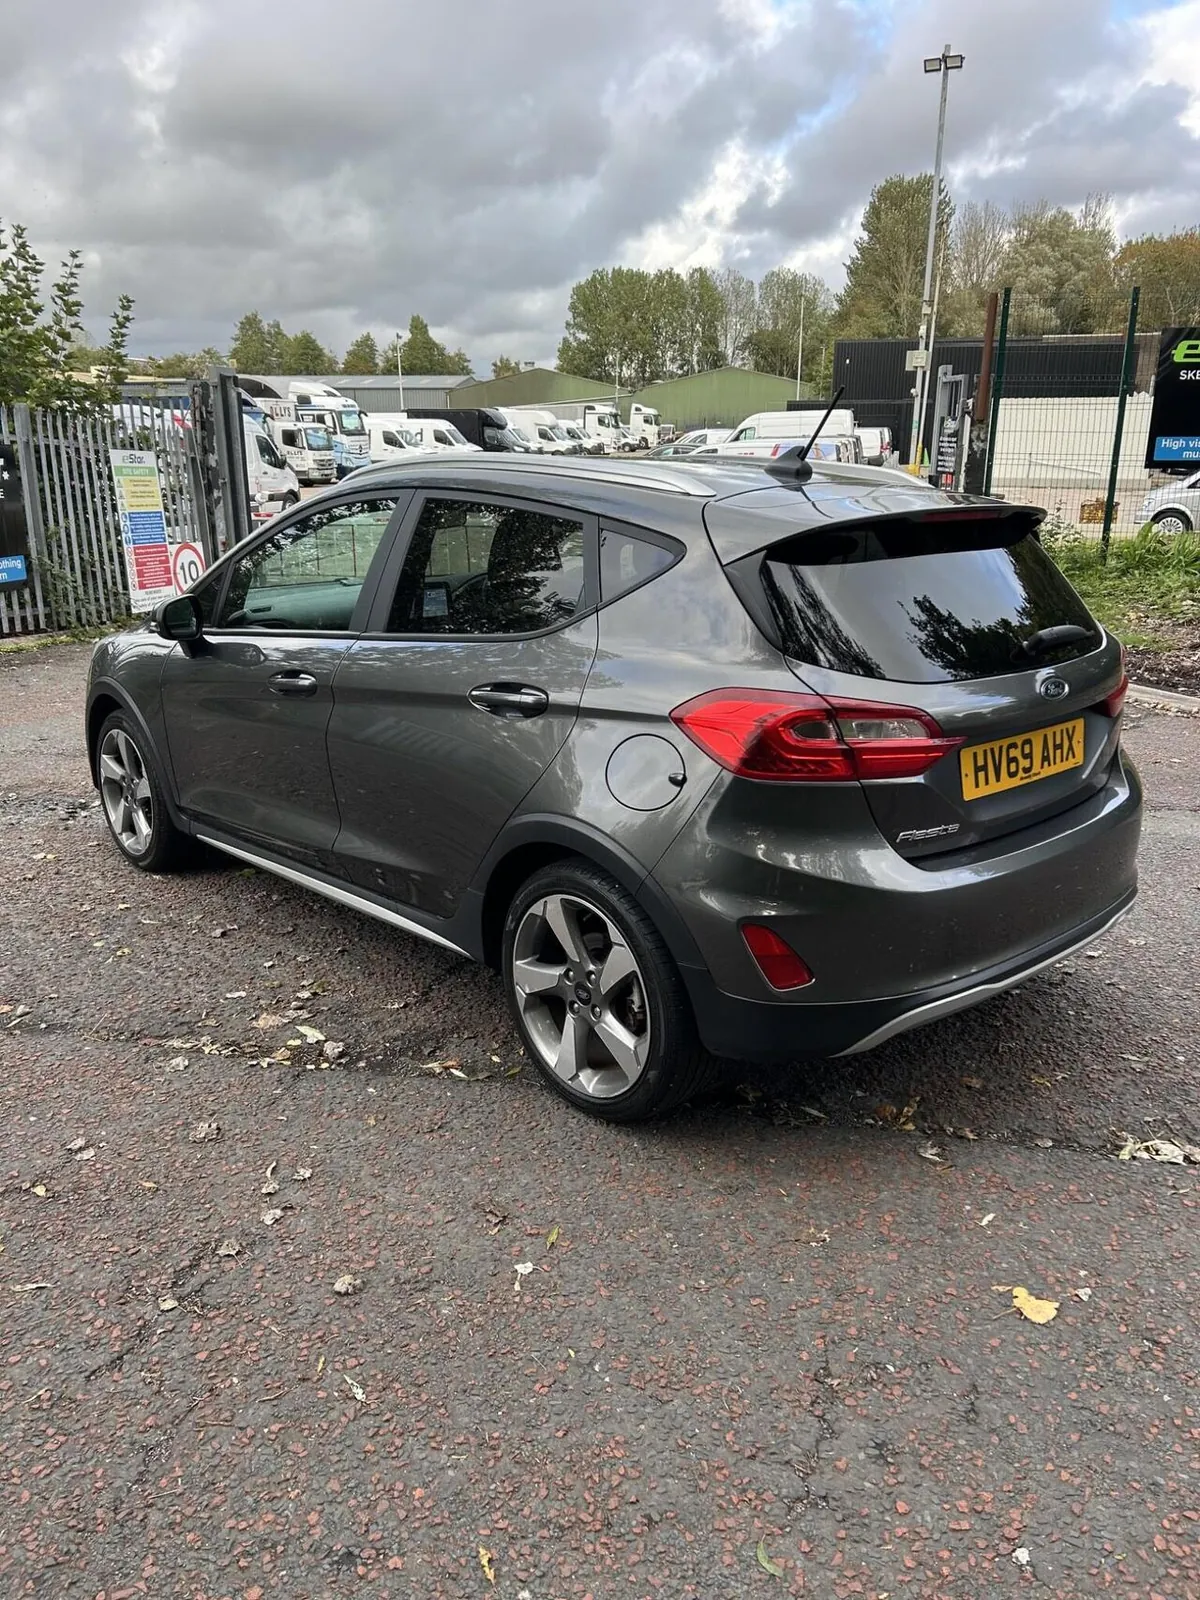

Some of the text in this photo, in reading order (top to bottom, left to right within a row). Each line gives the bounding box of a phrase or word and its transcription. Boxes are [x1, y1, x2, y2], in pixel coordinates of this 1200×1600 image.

[1161, 439, 1186, 450] High
[180, 560, 200, 585] 10
[973, 725, 1076, 788] HV69 AHX
[896, 823, 960, 843] Fiesta
